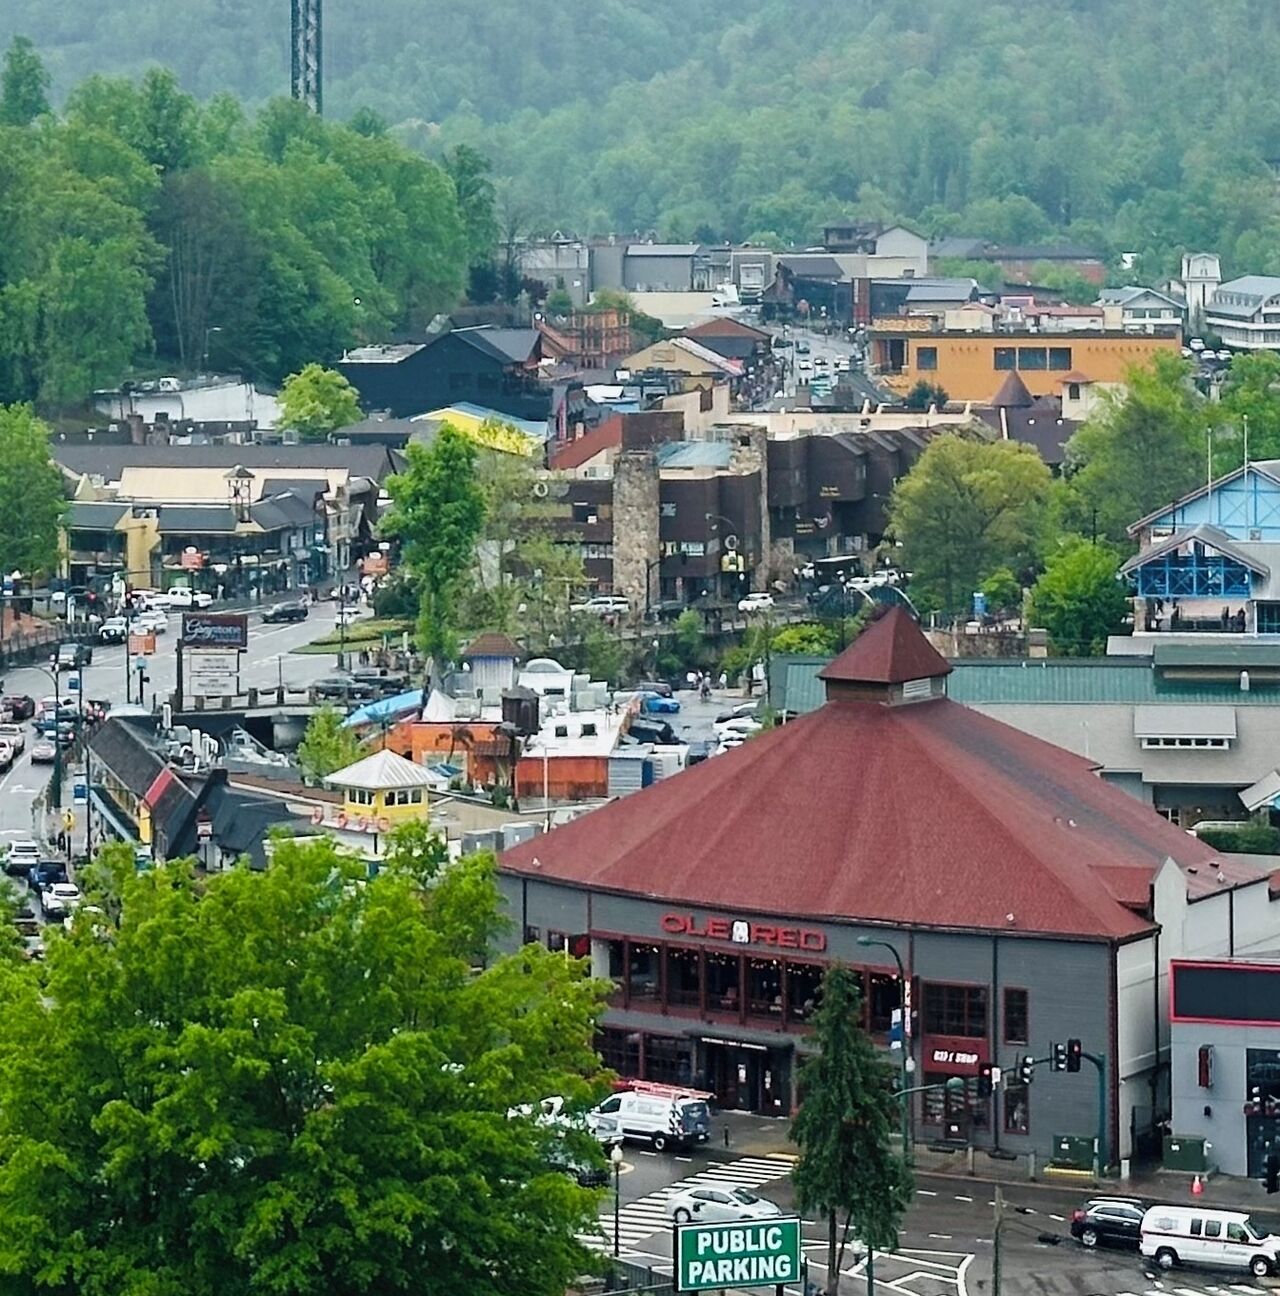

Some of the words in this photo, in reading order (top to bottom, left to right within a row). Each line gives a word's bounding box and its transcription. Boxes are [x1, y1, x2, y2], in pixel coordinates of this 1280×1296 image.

[660, 912, 730, 940] OLE
[751, 922, 827, 952] RED
[697, 1227, 783, 1255] PUBLIC
[688, 1254, 792, 1284] PARKING
